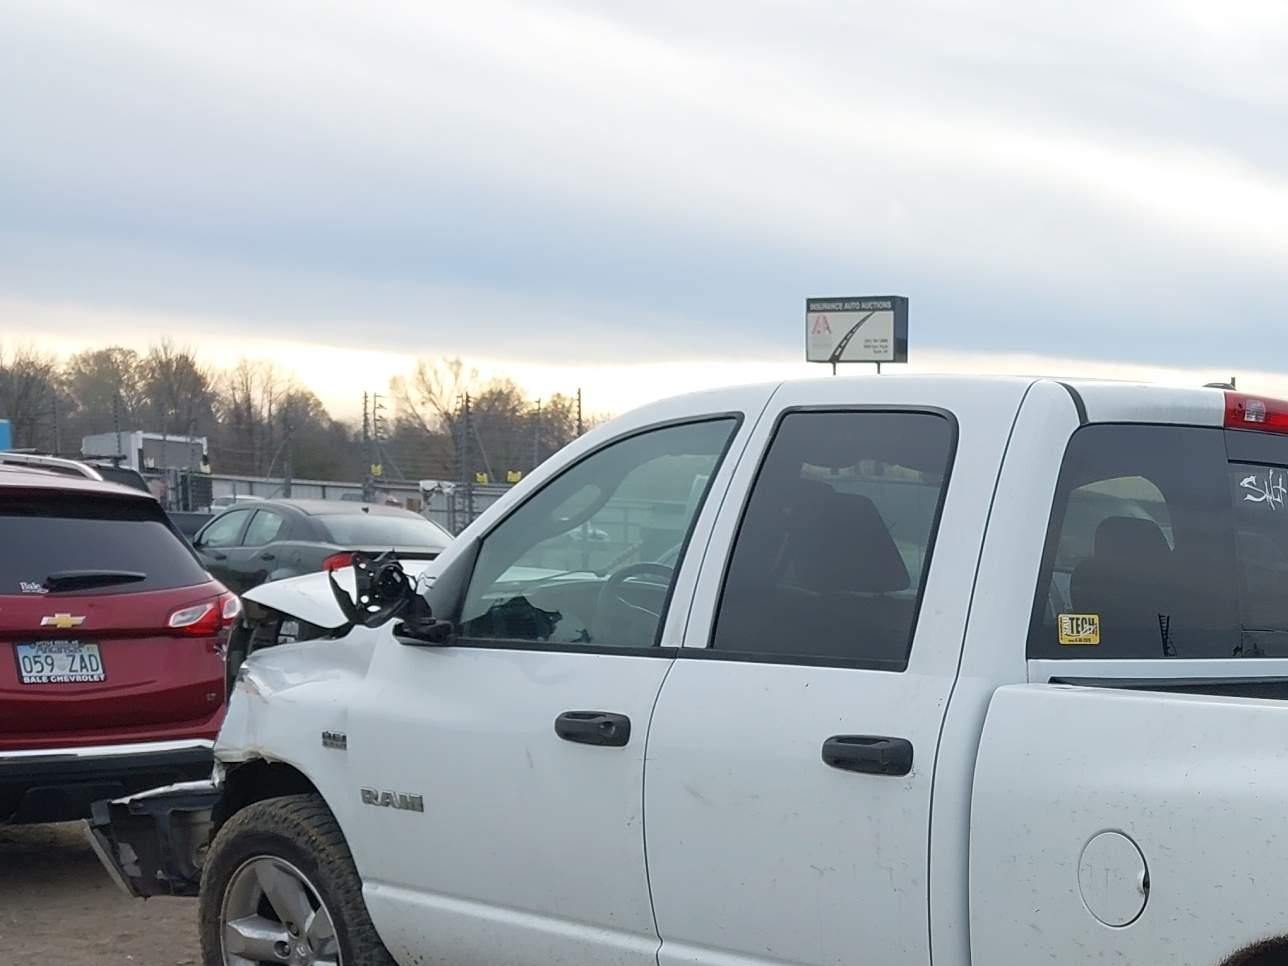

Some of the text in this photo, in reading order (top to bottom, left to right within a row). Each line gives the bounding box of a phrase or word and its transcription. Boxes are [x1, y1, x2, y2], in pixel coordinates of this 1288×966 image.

[1069, 616, 1095, 635] TECH
[22, 654, 100, 674] 059 ZAD
[50, 674, 105, 682] CHEVROLET
[360, 787, 424, 813] RAM
